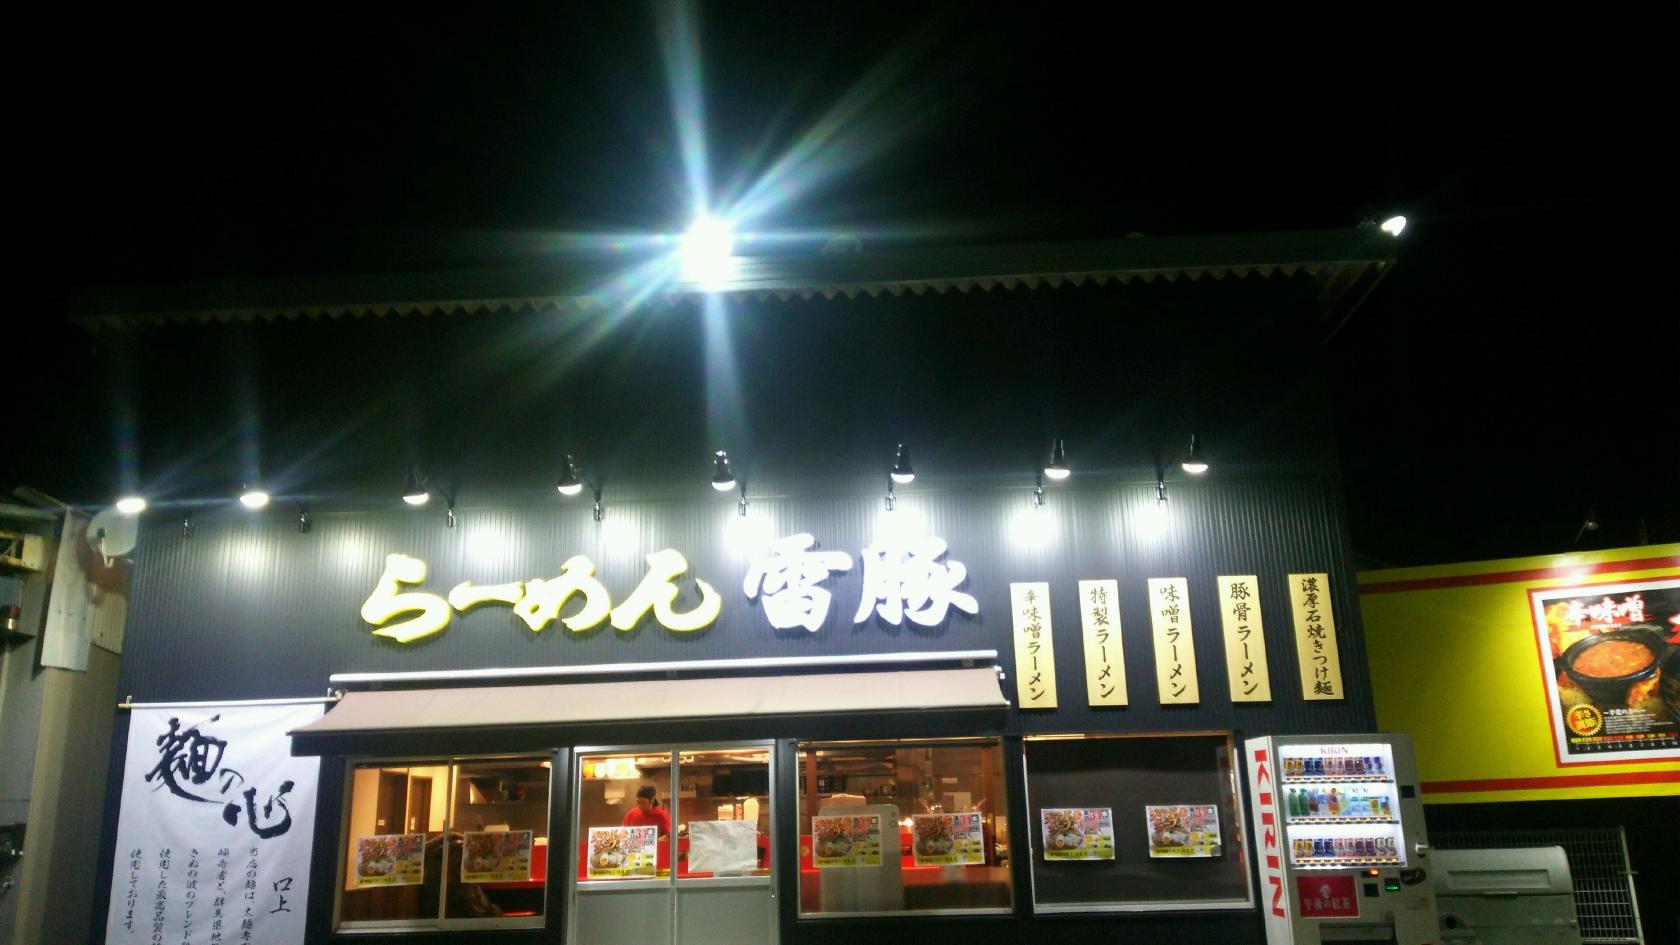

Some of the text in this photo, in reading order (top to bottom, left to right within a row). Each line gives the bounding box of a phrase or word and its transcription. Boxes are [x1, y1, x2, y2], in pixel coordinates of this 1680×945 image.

[361, 532, 980, 644] らーめん 雷豚
[1089, 586, 1116, 699] 特製ラーメン
[1159, 586, 1188, 698] 味噌ラーメン
[1230, 582, 1260, 696] 豚骨ラーメン
[1301, 577, 1335, 696] 濃厚石焼きつけ麺
[1022, 588, 1046, 702] 辛味噌ラーメン
[144, 713, 295, 840] 麺の心
[1320, 746, 1349, 755] KIRIN
[1254, 749, 1286, 919] KIRIN
[270, 876, 293, 914] 口上
